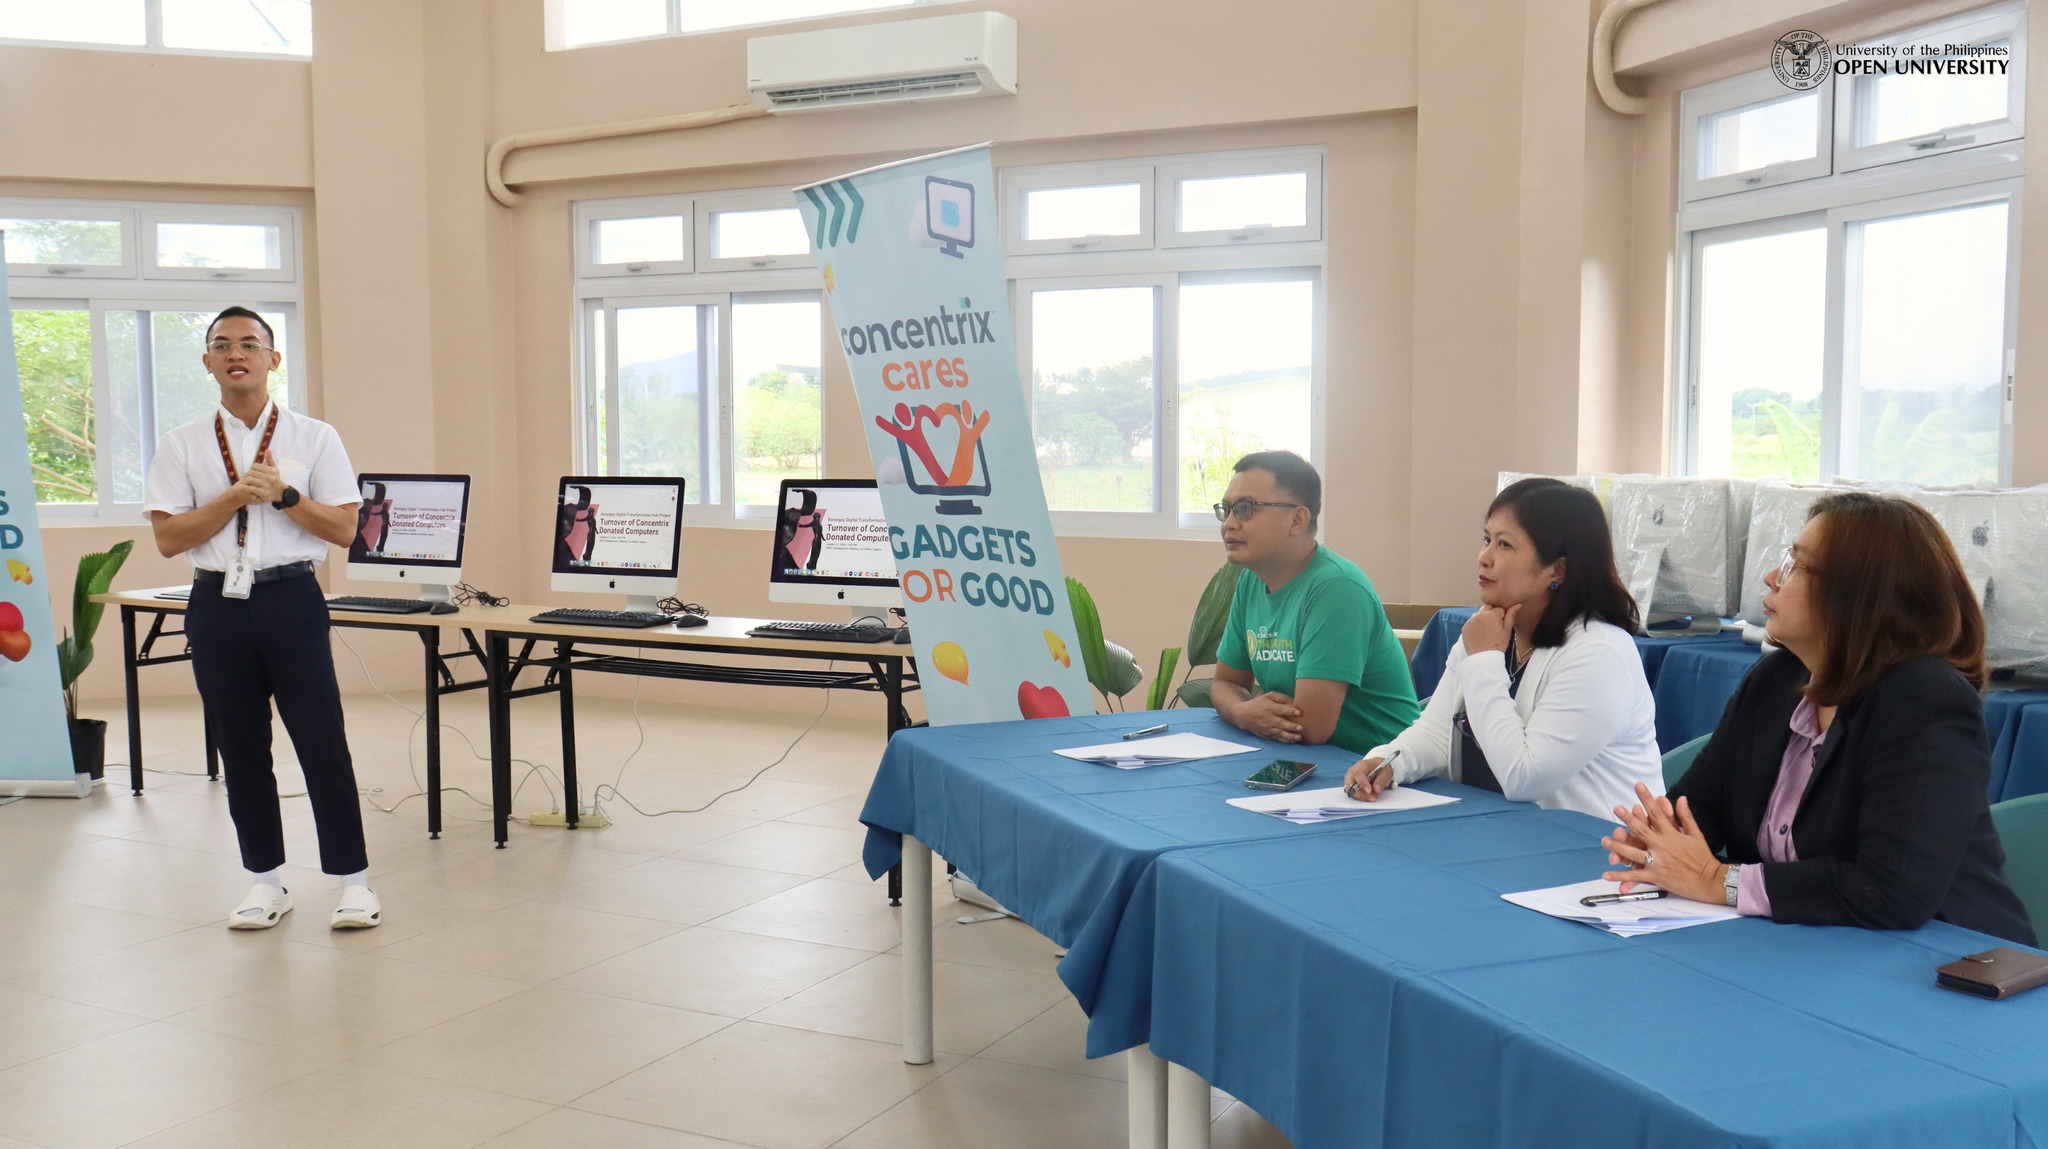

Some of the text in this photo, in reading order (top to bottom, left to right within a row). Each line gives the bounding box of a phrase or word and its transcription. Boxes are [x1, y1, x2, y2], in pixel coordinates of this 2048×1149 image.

[841, 297, 995, 356] concentrix
[882, 356, 969, 392] cares
[600, 518, 627, 526] Turnover
[636, 519, 669, 527] Concentrix
[625, 528, 659, 536] Computers
[827, 524, 888, 533] Turnover of Conc
[0, 524, 24, 549] D
[856, 534, 890, 543] Compute
[888, 524, 1036, 567] GADGETS
[900, 568, 1054, 616] OR GOOD
